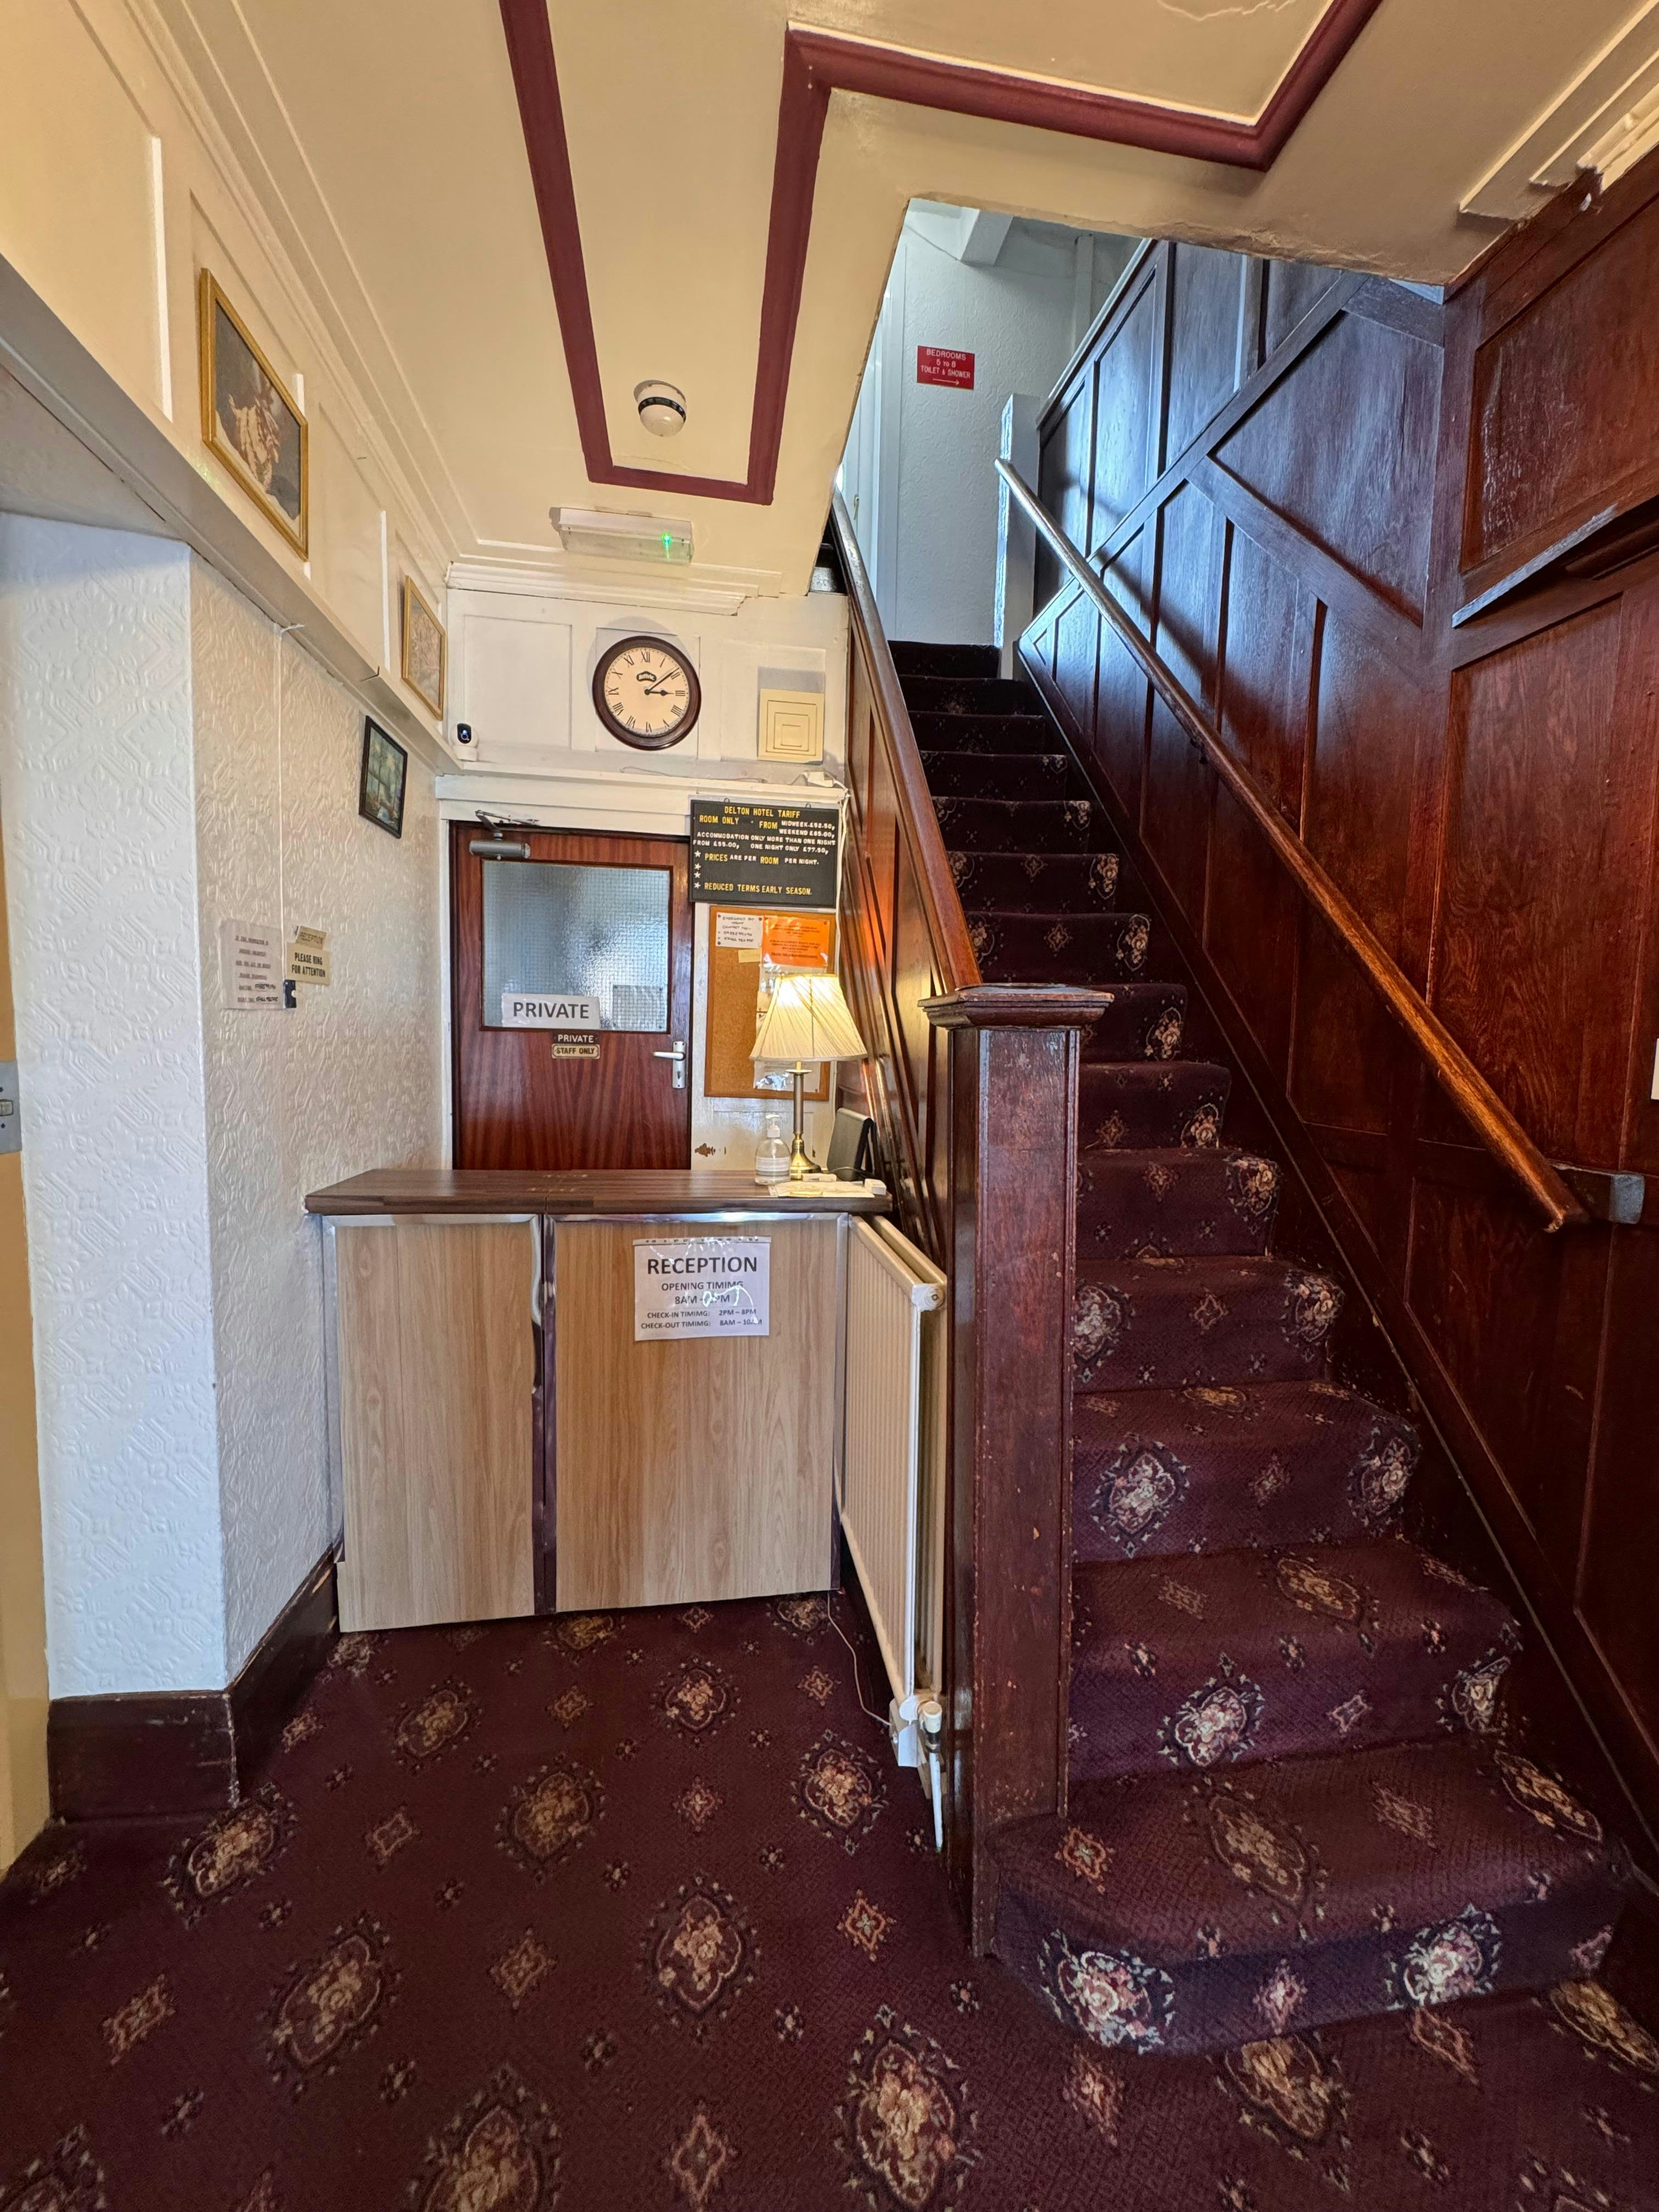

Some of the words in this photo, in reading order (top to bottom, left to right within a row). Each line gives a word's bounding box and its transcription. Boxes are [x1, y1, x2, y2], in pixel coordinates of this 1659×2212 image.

[927, 349, 966, 360] BEDROOMS
[921, 365, 940, 374] TOILET
[948, 369, 970, 379] SHOWER
[725, 806, 749, 815] DELTON
[753, 808, 774, 817] HOTEL
[778, 809, 800, 819] TARIFF
[699, 815, 718, 823] ROOM
[722, 816, 739, 825] ONLY
[759, 821, 778, 830] FROM
[697, 831, 749, 840] ACCOMMODATION
[705, 853, 728, 861] PRICES
[760, 856, 778, 865] ROOM
[704, 883, 733, 891] REDUCED
[738, 884, 760, 893] TERMS
[762, 885, 782, 894] EARLY
[295, 952, 312, 963] PLEASE
[313, 956, 323, 965] RING
[292, 964, 301, 974] FOR
[302, 966, 325, 977] ATTENTION
[514, 1002, 589, 1019] PRIVATE
[558, 1035, 594, 1043] PRIVATE
[647, 1257, 757, 1274] RECEPTION
[662, 1282, 704, 1291] OPENING
[675, 1295, 697, 1305] 8AM
